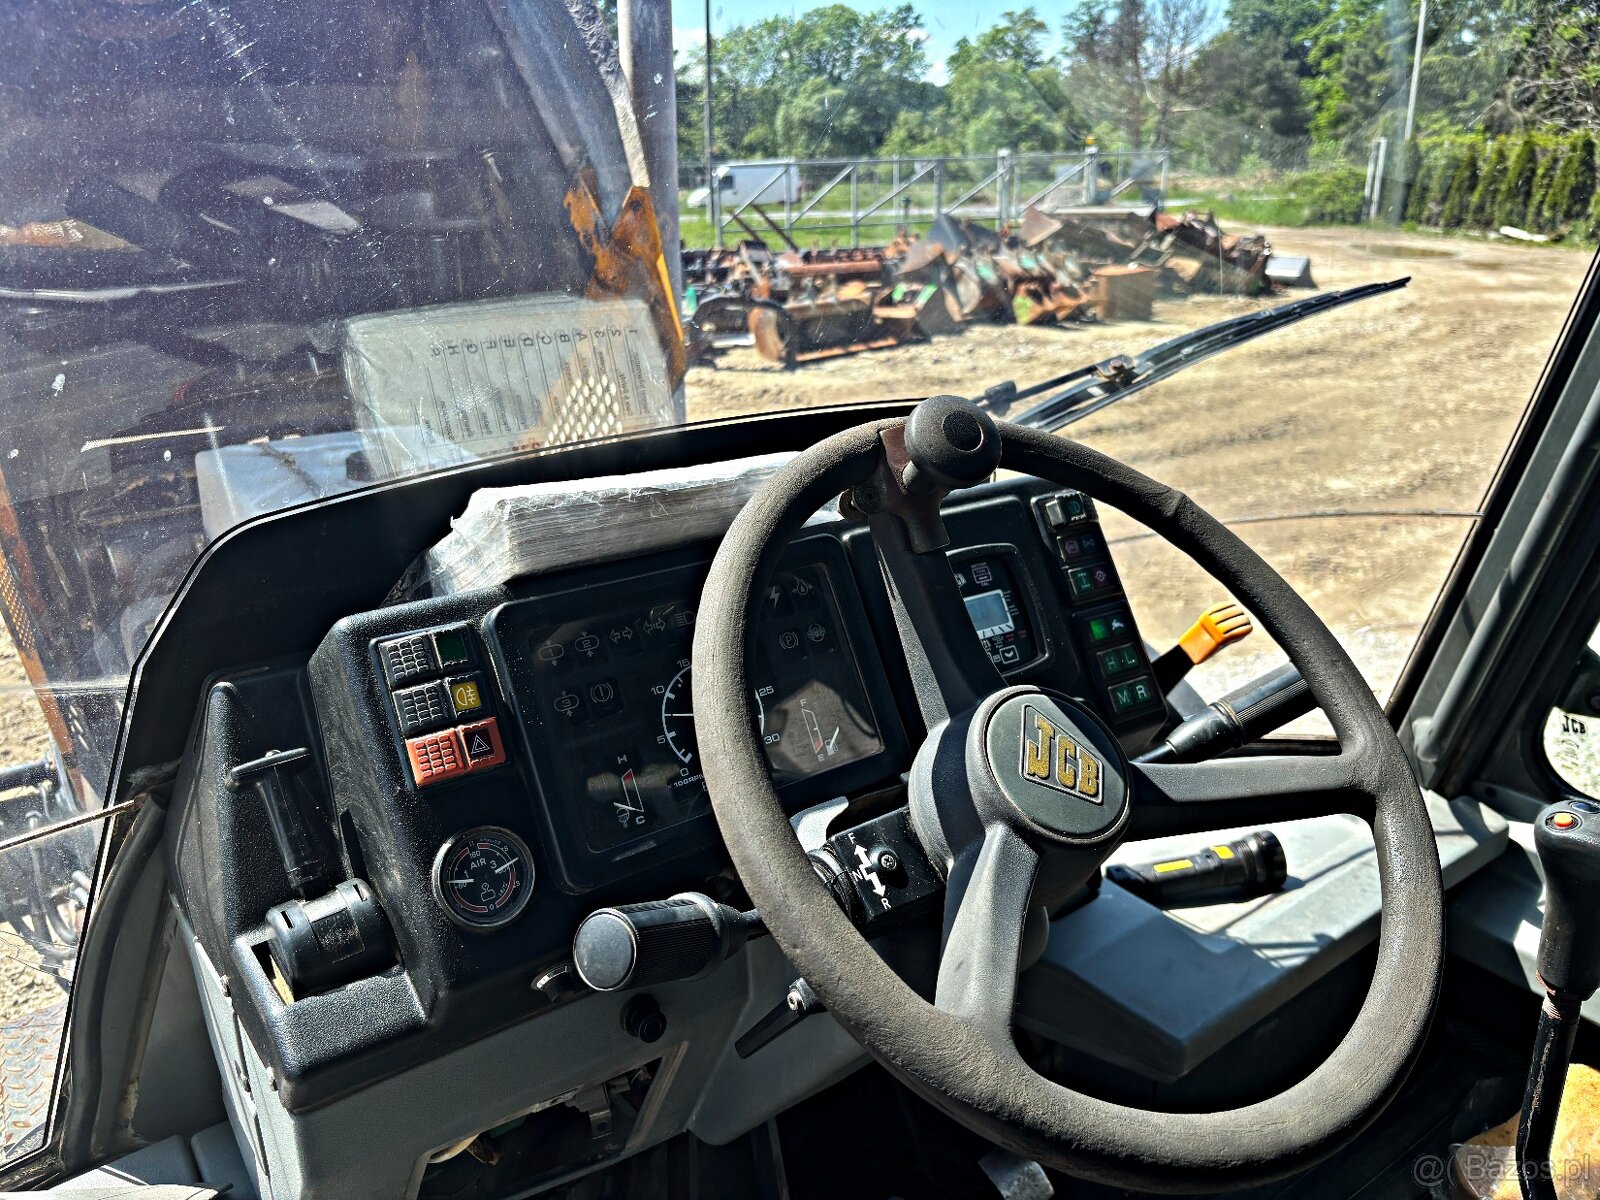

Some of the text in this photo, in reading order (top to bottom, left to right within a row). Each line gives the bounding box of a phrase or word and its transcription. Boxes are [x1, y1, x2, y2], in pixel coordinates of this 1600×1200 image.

[677, 659, 690, 668] 15
[1106, 651, 1136, 670] H L
[650, 685, 665, 696] 10
[759, 685, 774, 697] 25
[1117, 684, 1147, 704] M R
[1562, 714, 1587, 734] JCB
[656, 735, 666, 744] 5
[764, 733, 781, 744] 30
[617, 754, 628, 765] H
[817, 754, 825, 762] E
[1024, 714, 1099, 797] JCB
[680, 767, 689, 777] 0
[635, 815, 645, 825] C
[848, 832, 856, 845] F
[470, 858, 487, 870] AIR
[490, 860, 498, 869] 3
[852, 868, 864, 881] N
[880, 897, 892, 910] R
